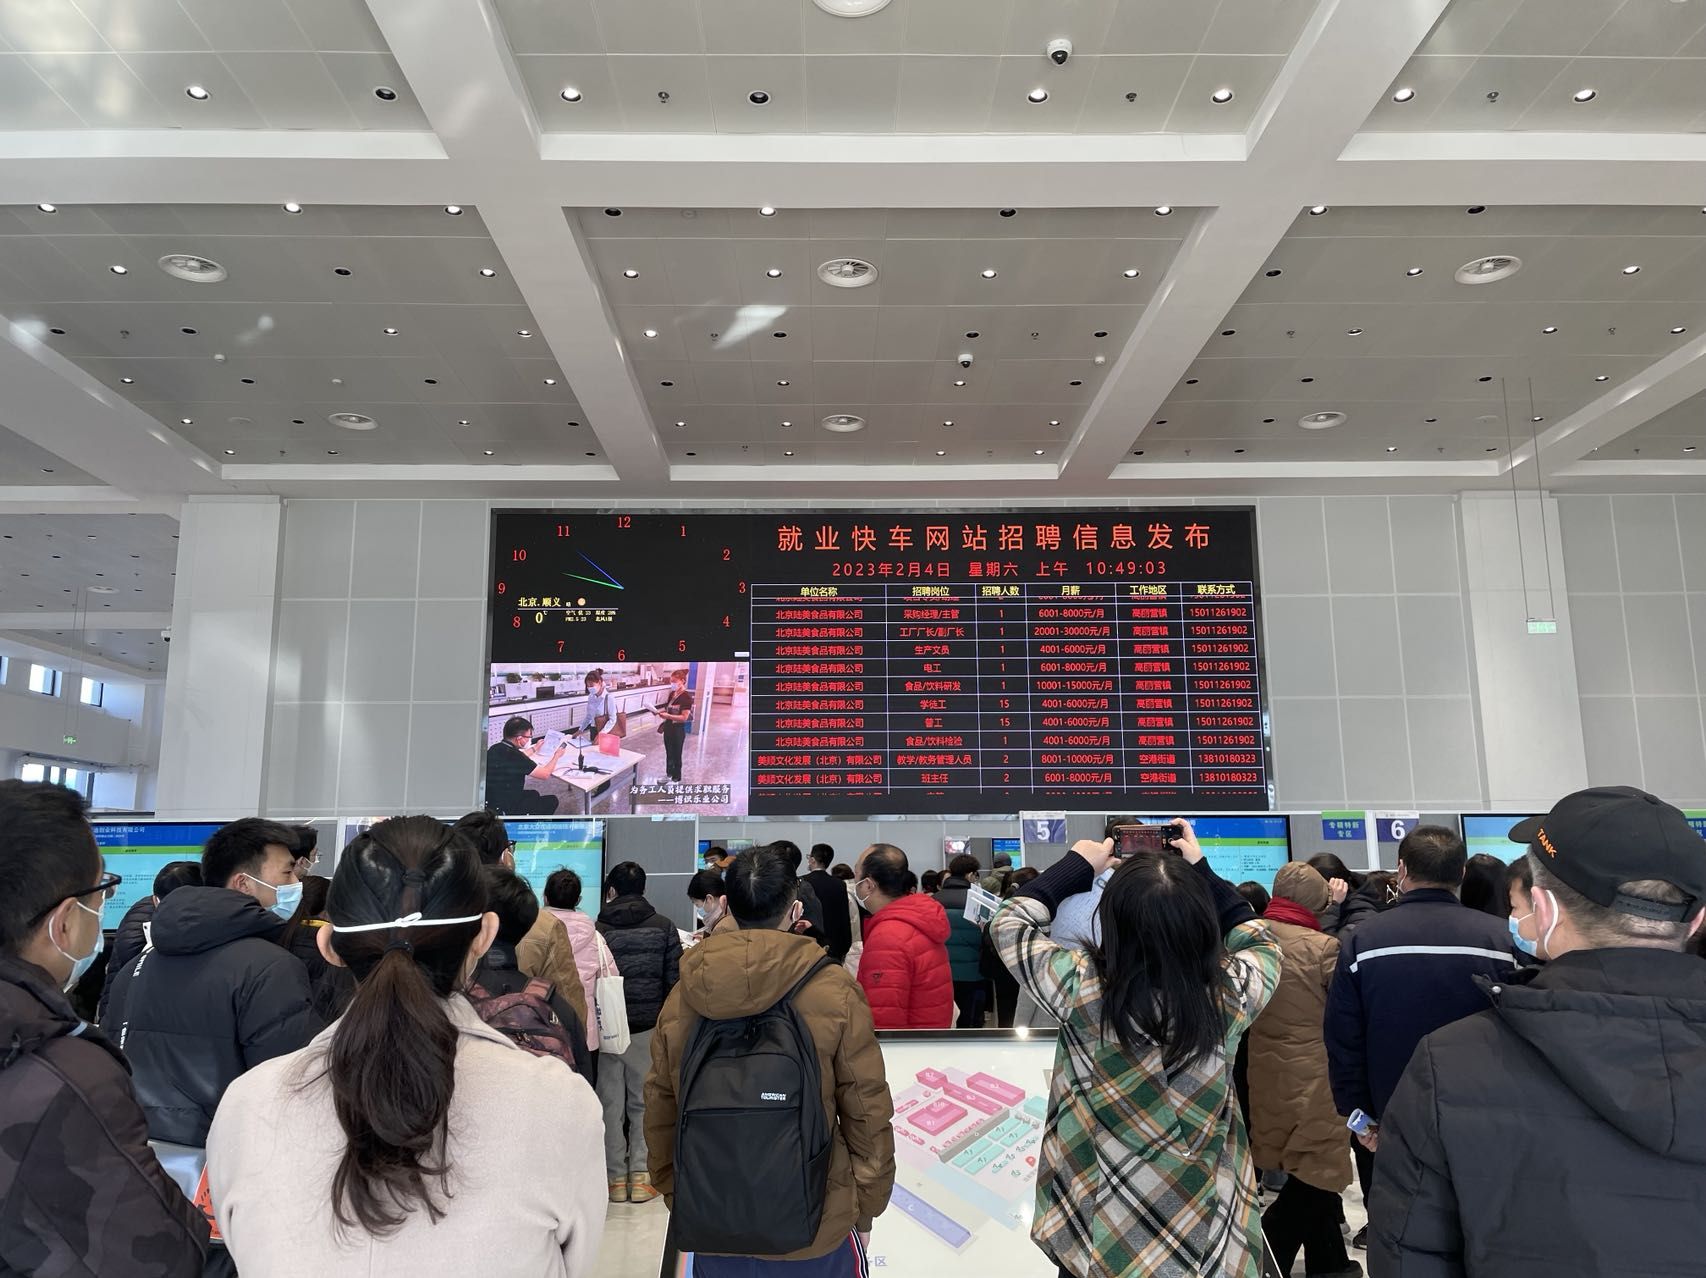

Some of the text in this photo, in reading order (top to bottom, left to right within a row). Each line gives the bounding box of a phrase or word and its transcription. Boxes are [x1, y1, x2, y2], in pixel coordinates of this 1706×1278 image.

[617, 516, 631, 529] 12
[556, 526, 570, 537] 11
[681, 526, 686, 537] 1
[777, 522, 1211, 552] 就业快车网站招聘信息发布
[512, 549, 527, 561] 10
[722, 549, 731, 561] 2
[832, 560, 1167, 578] 2023年2月4日 星期六 上午 10:49:03
[497, 582, 506, 594] 9
[738, 582, 747, 593] 3
[800, 584, 1235, 597] 单位名称 招聘岗位 招聘人数 月薪 工作地区 联系方式
[999, 608, 1004, 618] 1
[1038, 607, 1105, 619] 6001-8000元/月
[1190, 607, 1247, 617] 15011261902
[512, 616, 522, 628] 8
[722, 616, 731, 628] 4
[999, 626, 1004, 636] 1
[1034, 624, 1111, 637] 20001-30000元/月
[1191, 624, 1248, 635] 15011261902
[557, 641, 565, 653] 7
[678, 640, 686, 652] 5
[913, 643, 951, 656] 生产文员
[1000, 644, 1005, 654] 1
[1039, 642, 1106, 655] 4001-6000元/月
[1192, 642, 1249, 653] 15011261902
[617, 650, 626, 662] 6
[922, 662, 941, 674] 电工
[1000, 662, 1006, 672] 1
[1040, 660, 1107, 673] 6001-8000元/月
[1193, 660, 1250, 672] 15011261902
[1001, 680, 1006, 690] 1
[1036, 679, 1114, 692] 10001-15000元/月
[1194, 679, 1251, 690] 15011261902
[999, 698, 1010, 709] 15
[1041, 697, 1109, 710] 4001-6000元/月
[1195, 697, 1253, 708] 15011261902
[1000, 716, 1011, 727] 15
[1042, 716, 1110, 728] 4001-6000元/月
[1196, 716, 1254, 727] 15011261902
[1003, 735, 1008, 746] 1
[1042, 734, 1111, 746] 4001-6000元/月
[1197, 734, 1255, 745] 15011261902
[1003, 754, 1009, 764] 2
[1041, 753, 1114, 765] 8001-10000元/月
[1198, 753, 1257, 764] 13810180323
[921, 772, 949, 784] 班主任
[1004, 773, 1010, 783] 2
[1044, 771, 1113, 784] 6001-8000元/月
[1199, 771, 1258, 783] 13810180323
[1036, 820, 1051, 841] 5
[1390, 819, 1406, 840] 6
[1537, 828, 1558, 858] TANK
